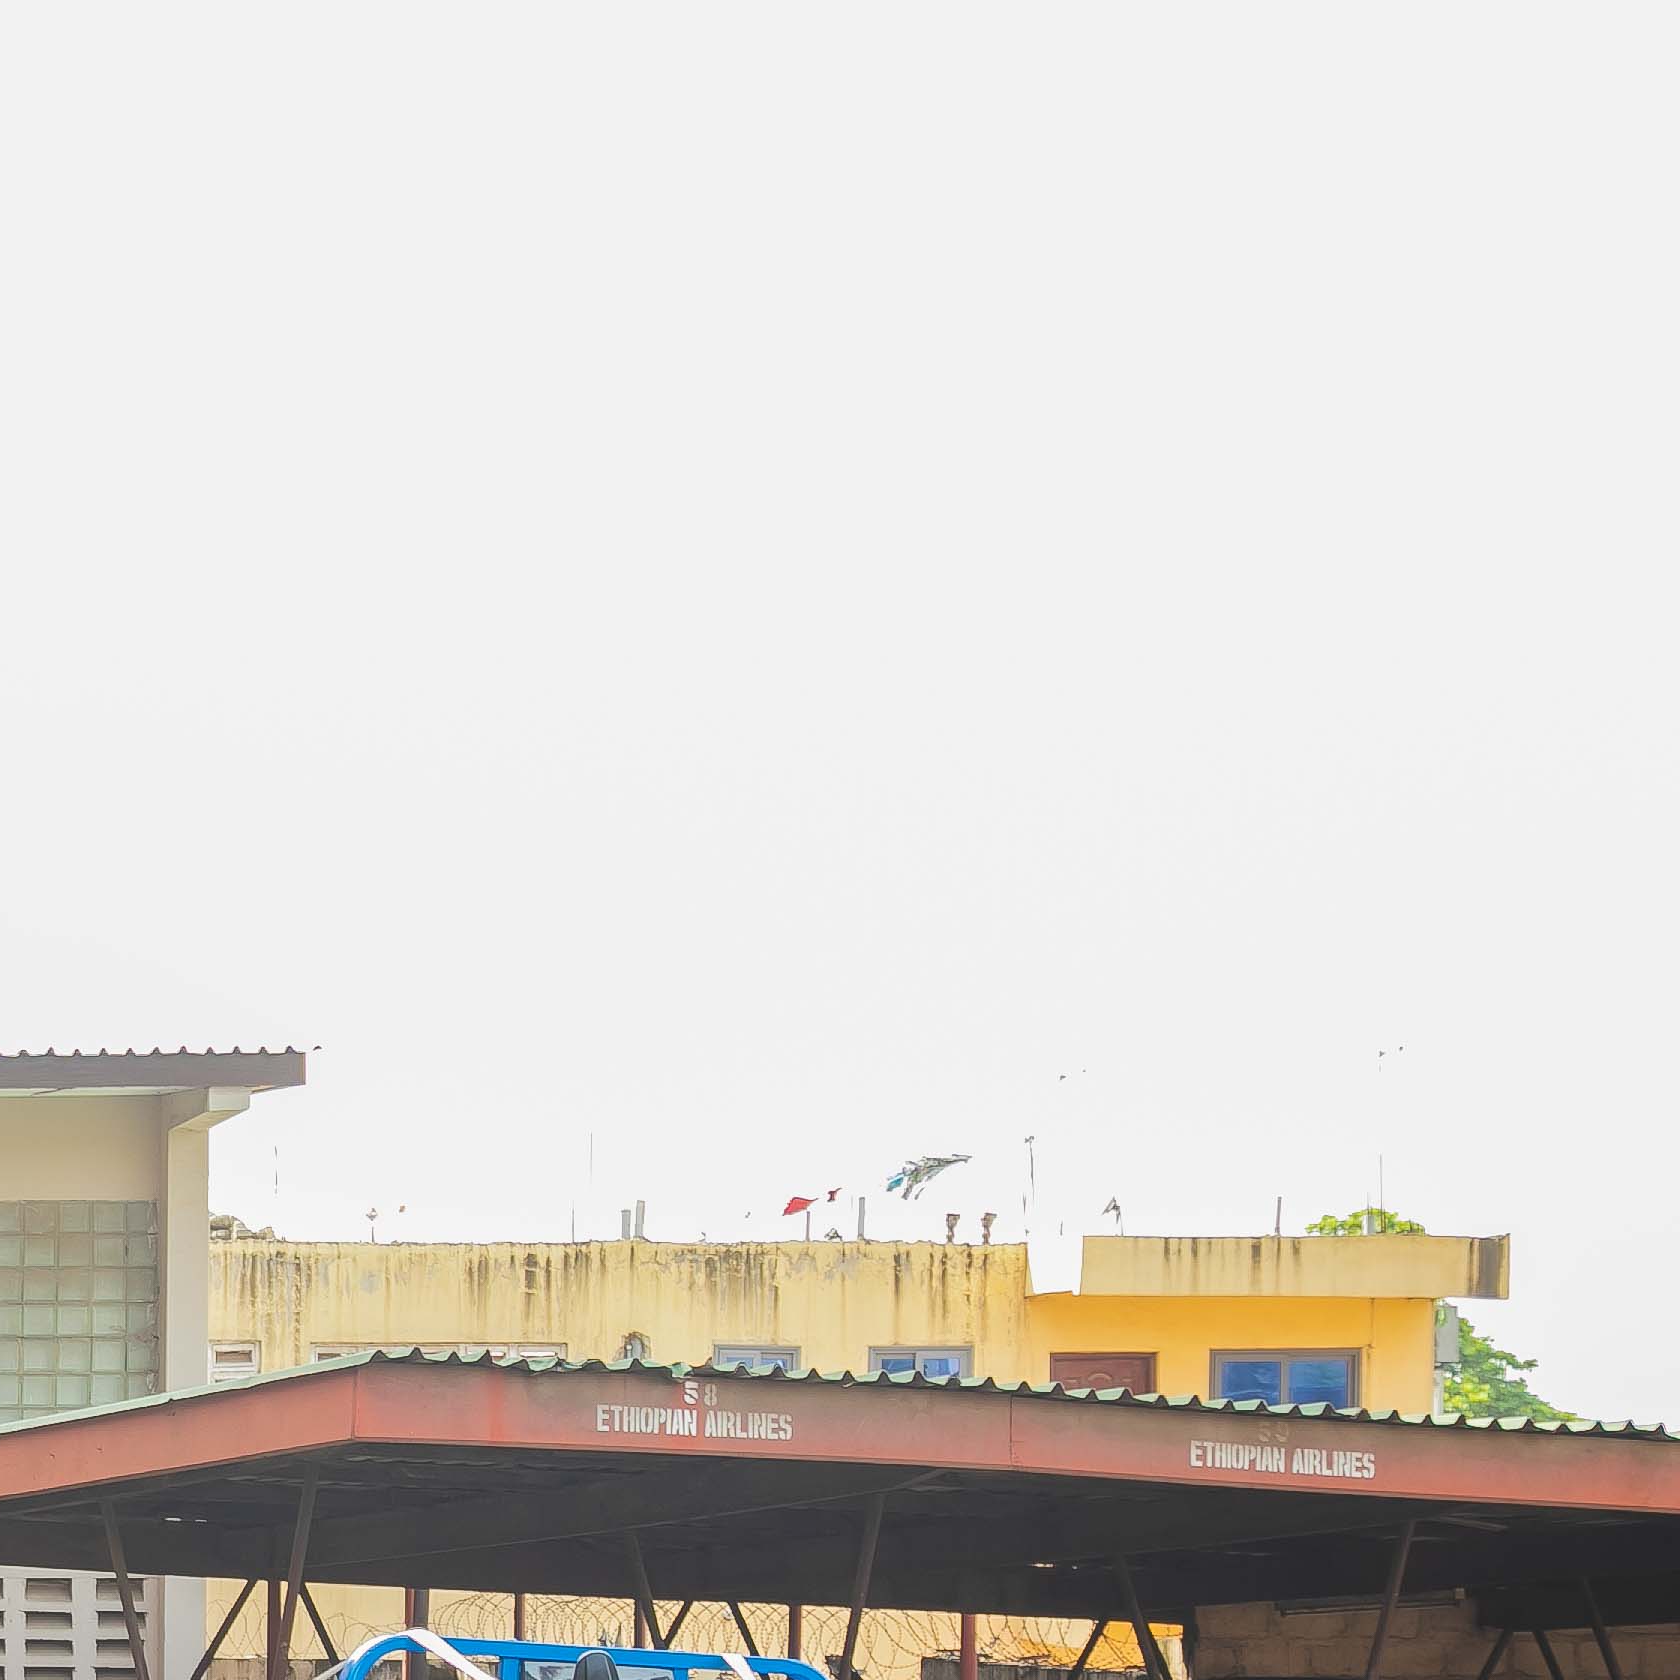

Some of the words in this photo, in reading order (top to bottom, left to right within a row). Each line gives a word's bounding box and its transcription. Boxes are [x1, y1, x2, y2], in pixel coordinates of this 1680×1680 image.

[596, 1404, 698, 1437] ETHIOPIAN
[704, 1410, 793, 1441] AIRLINES
[1190, 1439, 1285, 1474] ETHIOPIAN
[1292, 1448, 1376, 1479] AIRLINES
